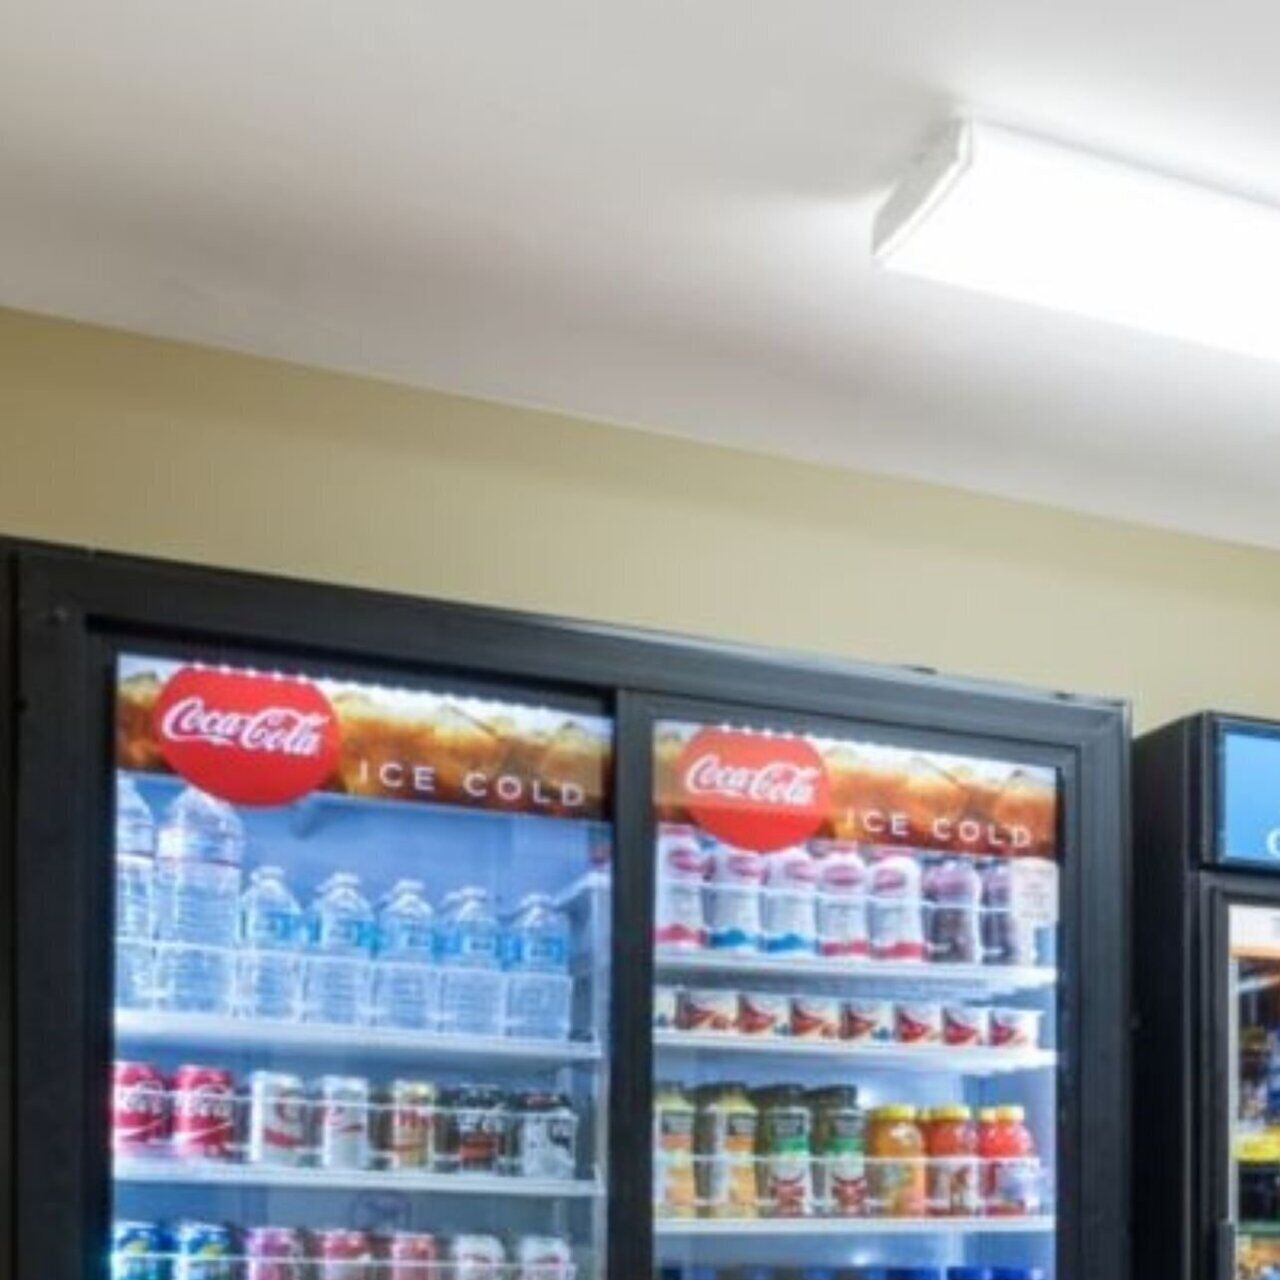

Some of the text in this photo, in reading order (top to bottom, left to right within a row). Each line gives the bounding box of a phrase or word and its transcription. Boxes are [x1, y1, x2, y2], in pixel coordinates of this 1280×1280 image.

[359, 761, 586, 807] ICE COLD
[845, 809, 1032, 848] ICE COLD
